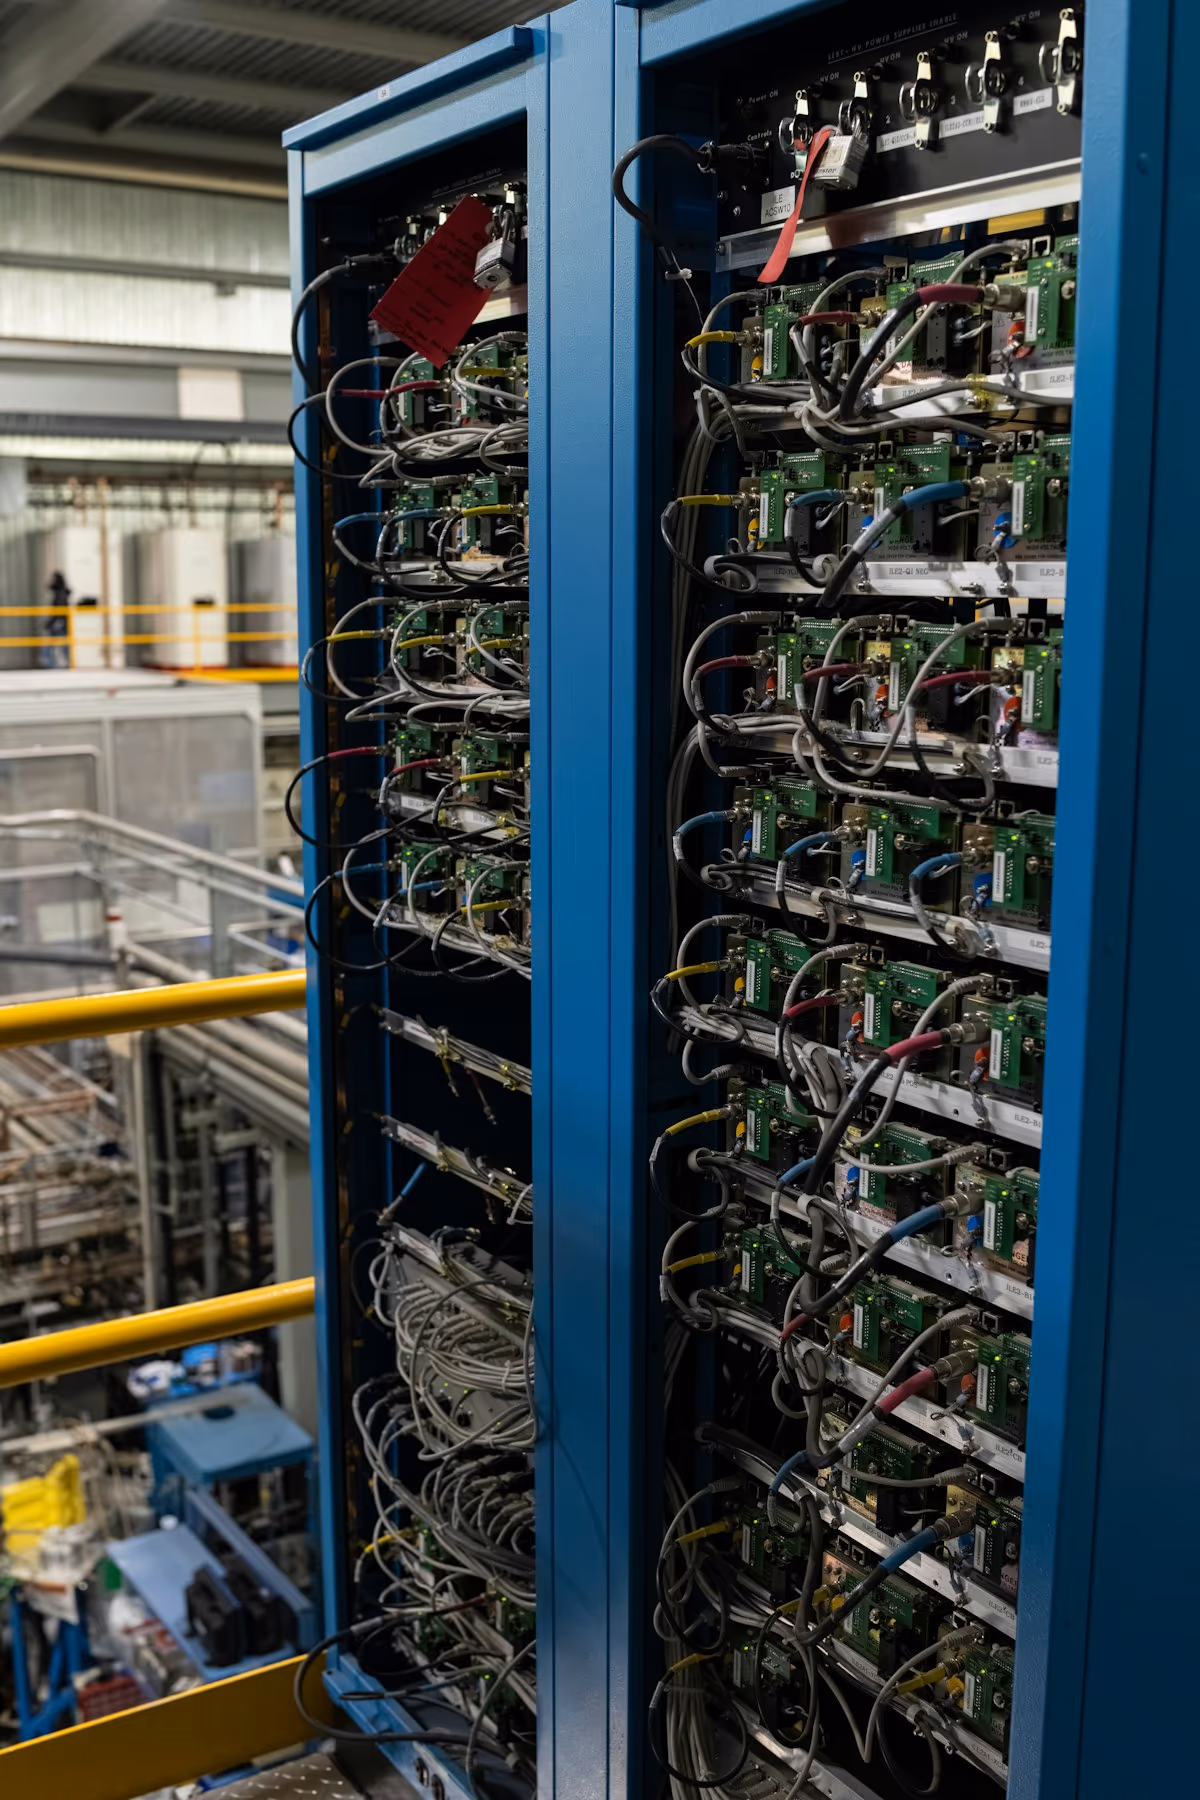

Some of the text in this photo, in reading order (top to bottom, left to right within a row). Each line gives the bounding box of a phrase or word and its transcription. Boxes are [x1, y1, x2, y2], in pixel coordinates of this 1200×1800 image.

[1028, 9, 1041, 20] ON
[865, 33, 890, 49] POWER
[893, 22, 926, 40] SUPPLIES
[956, 31, 969, 42] ON
[890, 51, 902, 62] ON
[830, 71, 840, 81] ON
[748, 88, 780, 104] Power ON
[747, 130, 773, 143] Controls
[772, 193, 783, 205] ILE
[764, 203, 792, 219] ACSW10
[889, 567, 930, 576] ILE2-Q1 NEG
